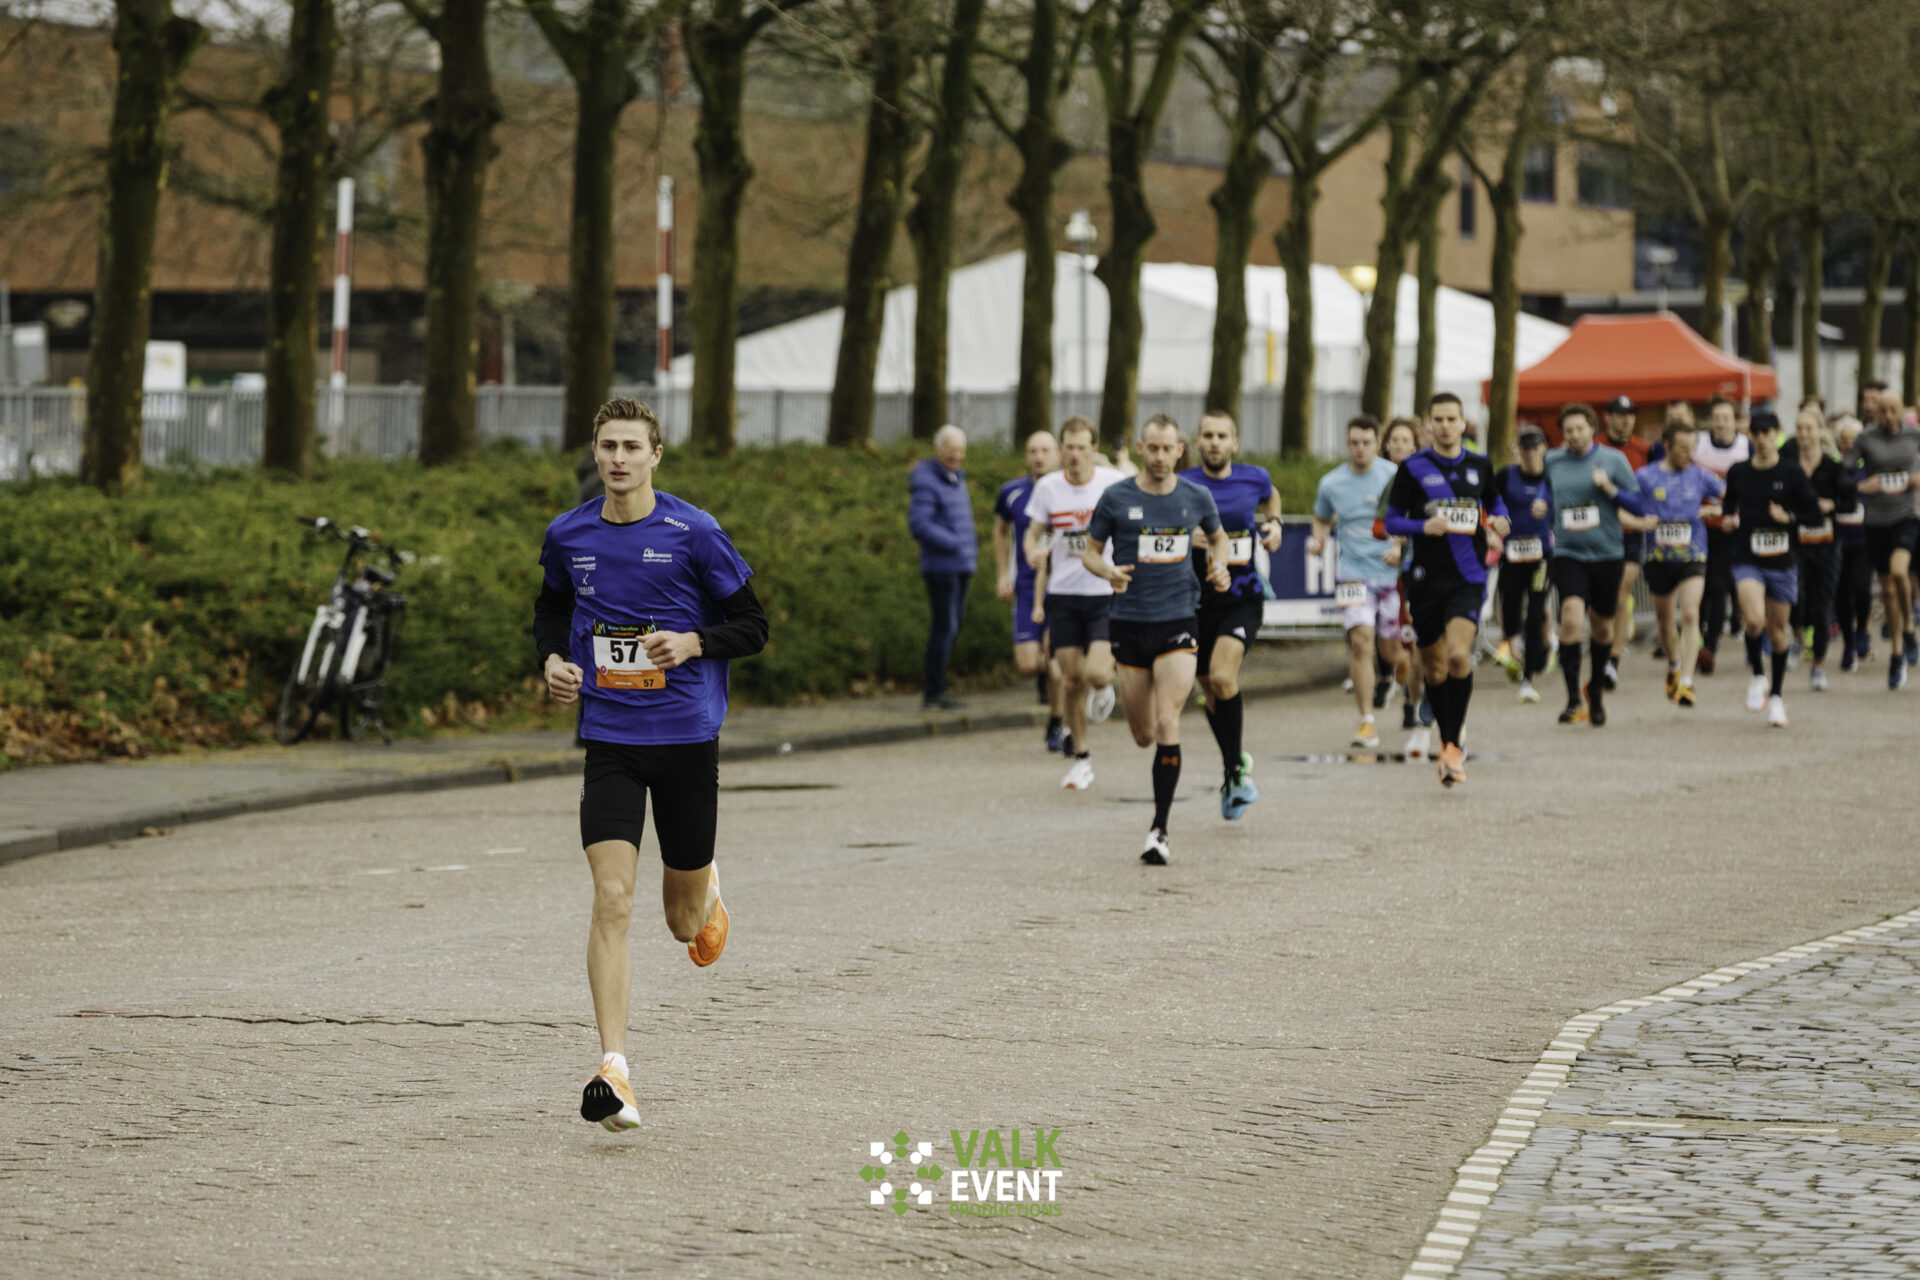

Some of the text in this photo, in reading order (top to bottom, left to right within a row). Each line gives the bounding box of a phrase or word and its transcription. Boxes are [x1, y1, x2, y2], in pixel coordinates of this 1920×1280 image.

[664, 516, 686, 529] CRAFT
[1154, 538, 1175, 552] 62
[610, 640, 639, 663] 57
[643, 679, 654, 687] 57
